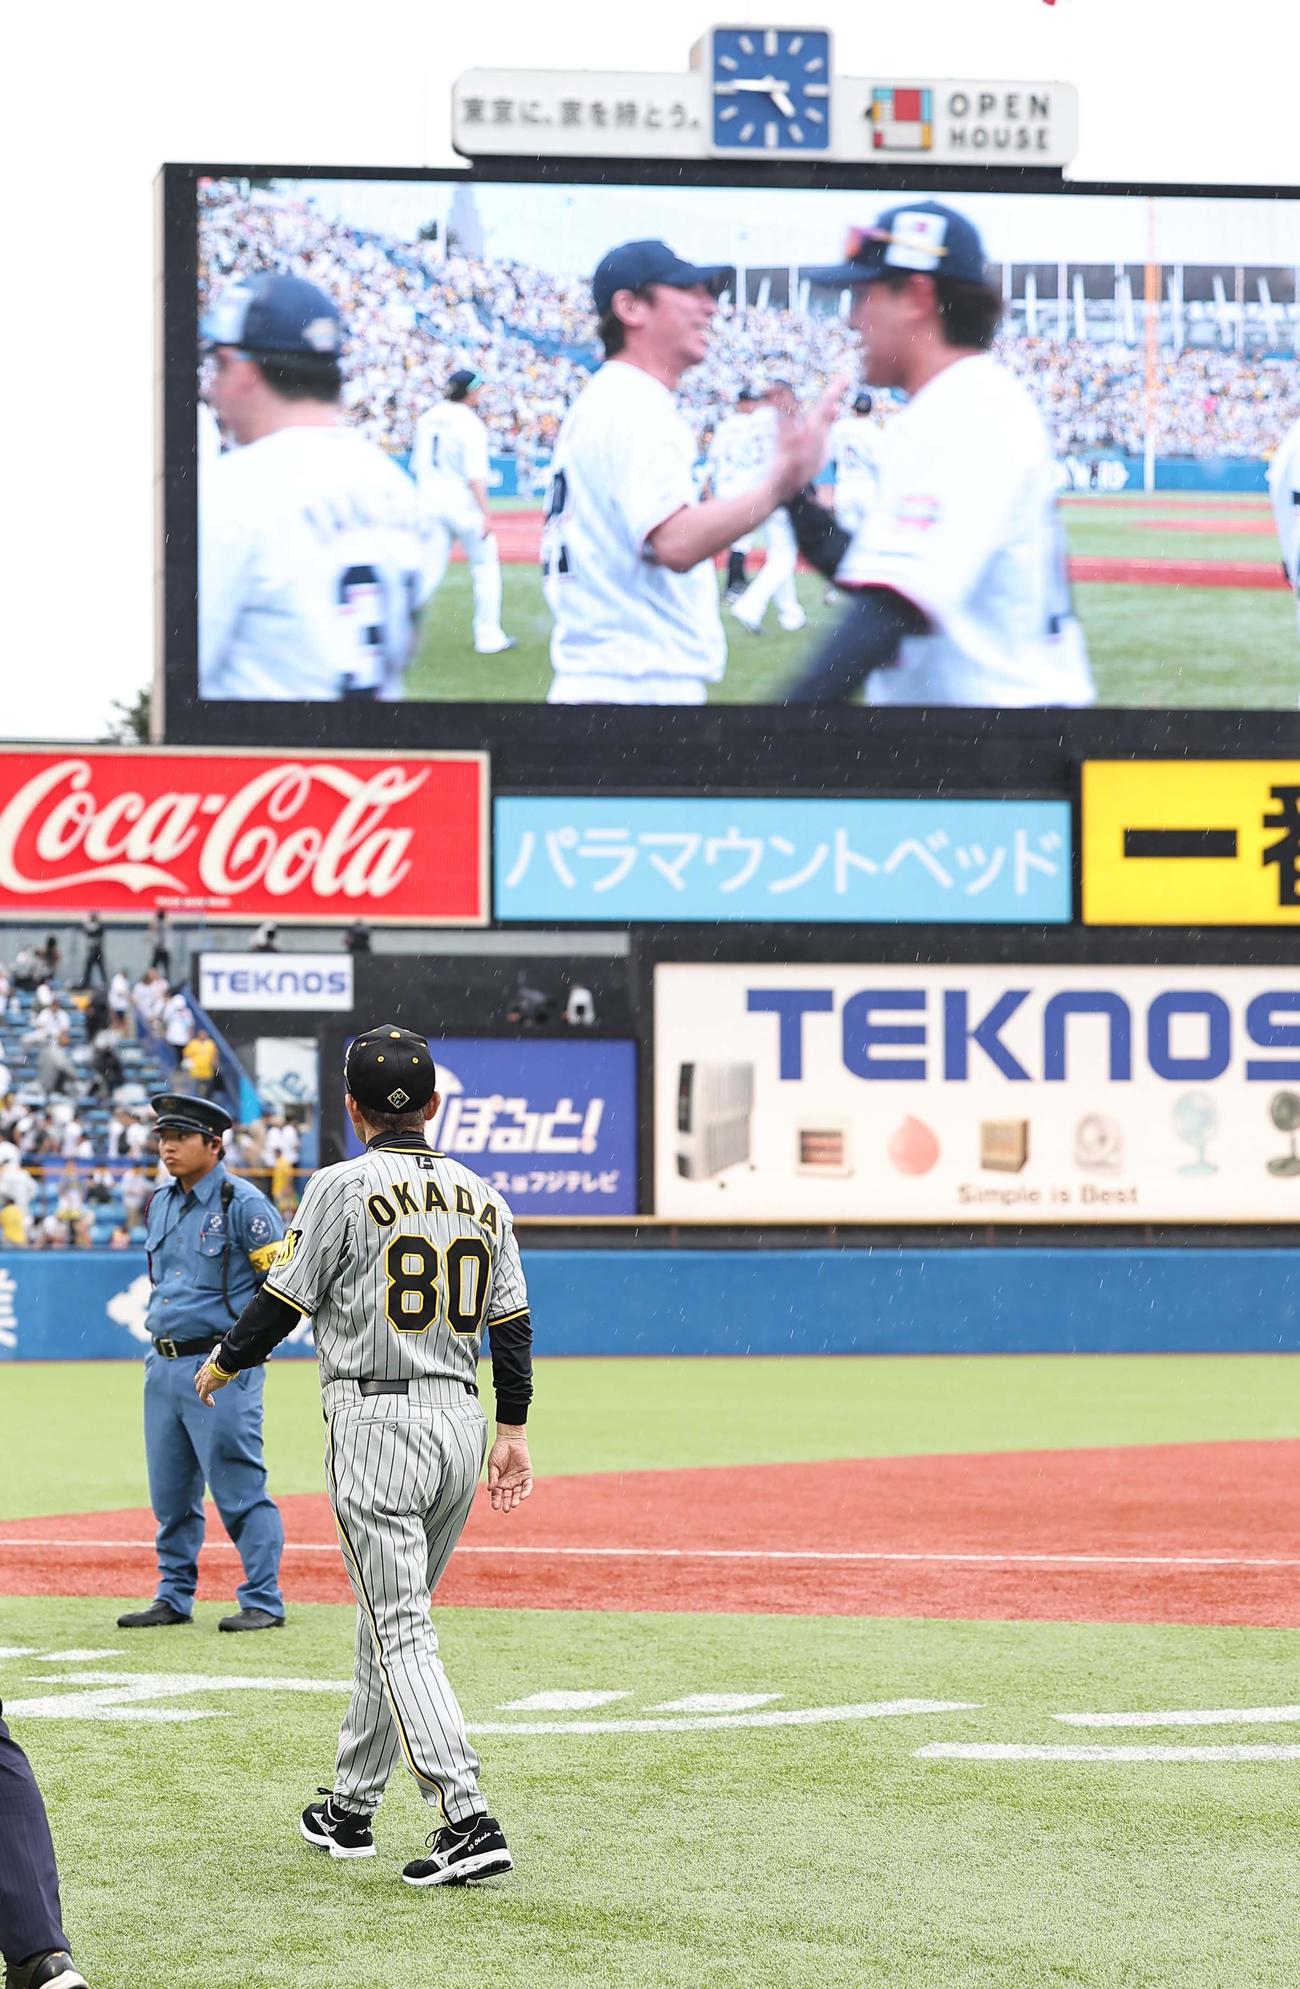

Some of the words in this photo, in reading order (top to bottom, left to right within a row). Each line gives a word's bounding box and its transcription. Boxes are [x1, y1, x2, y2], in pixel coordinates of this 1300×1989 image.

[949, 92, 1049, 119] OPEN
[951, 128, 1048, 150] HOUSE
[0, 759, 431, 897] Coca-Cola
[505, 826, 1062, 896] パラマウントベッド
[207, 971, 346, 994] TEKNOS
[746, 989, 1300, 1081] TEKNOS
[368, 1180, 498, 1235] OKADA
[959, 1184, 1042, 1207] Simple
[1050, 1186, 1072, 1204] is
[1081, 1185, 1138, 1205] Best
[385, 1234, 492, 1337] 80
